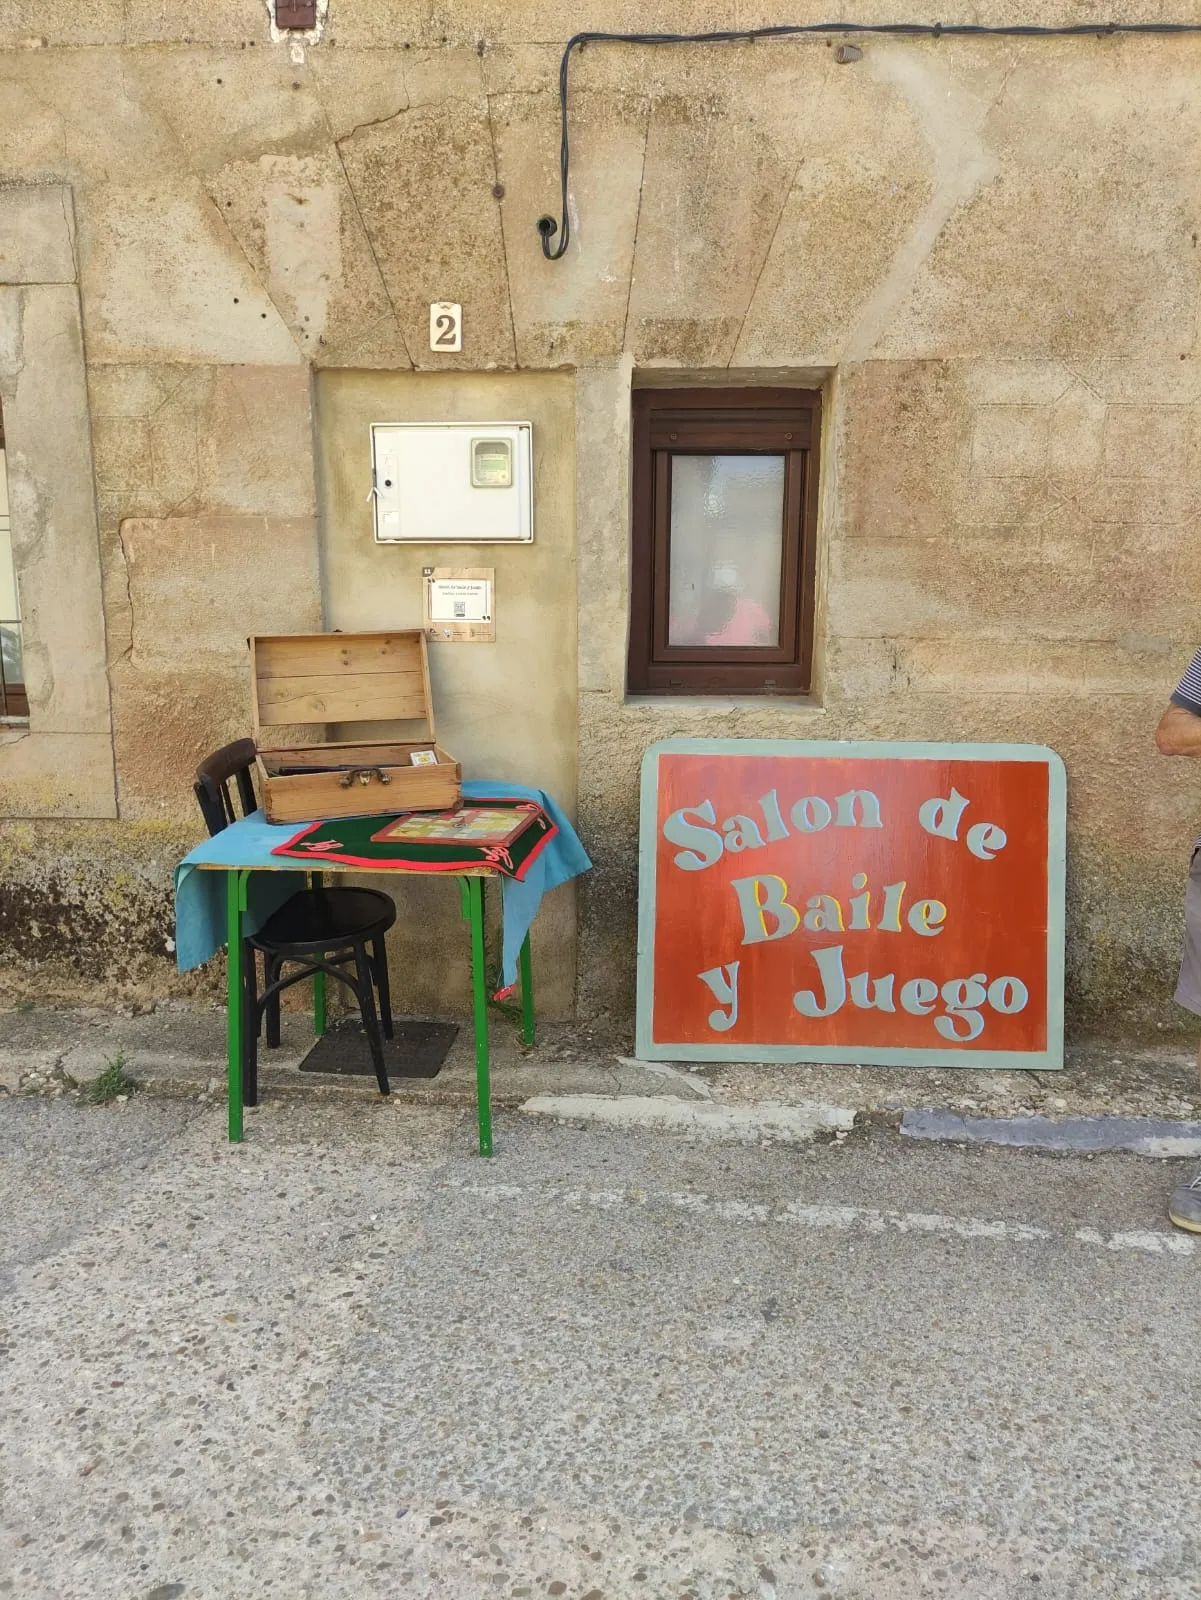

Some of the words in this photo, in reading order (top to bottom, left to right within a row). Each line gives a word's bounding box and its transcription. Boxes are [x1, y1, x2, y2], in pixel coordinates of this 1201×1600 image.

[436, 314, 456, 345] 2
[663, 789, 883, 871] Salon
[919, 787, 1008, 860] de
[730, 872, 947, 945] Baile
[697, 961, 741, 1032] y
[793, 945, 1029, 1042] Juego
